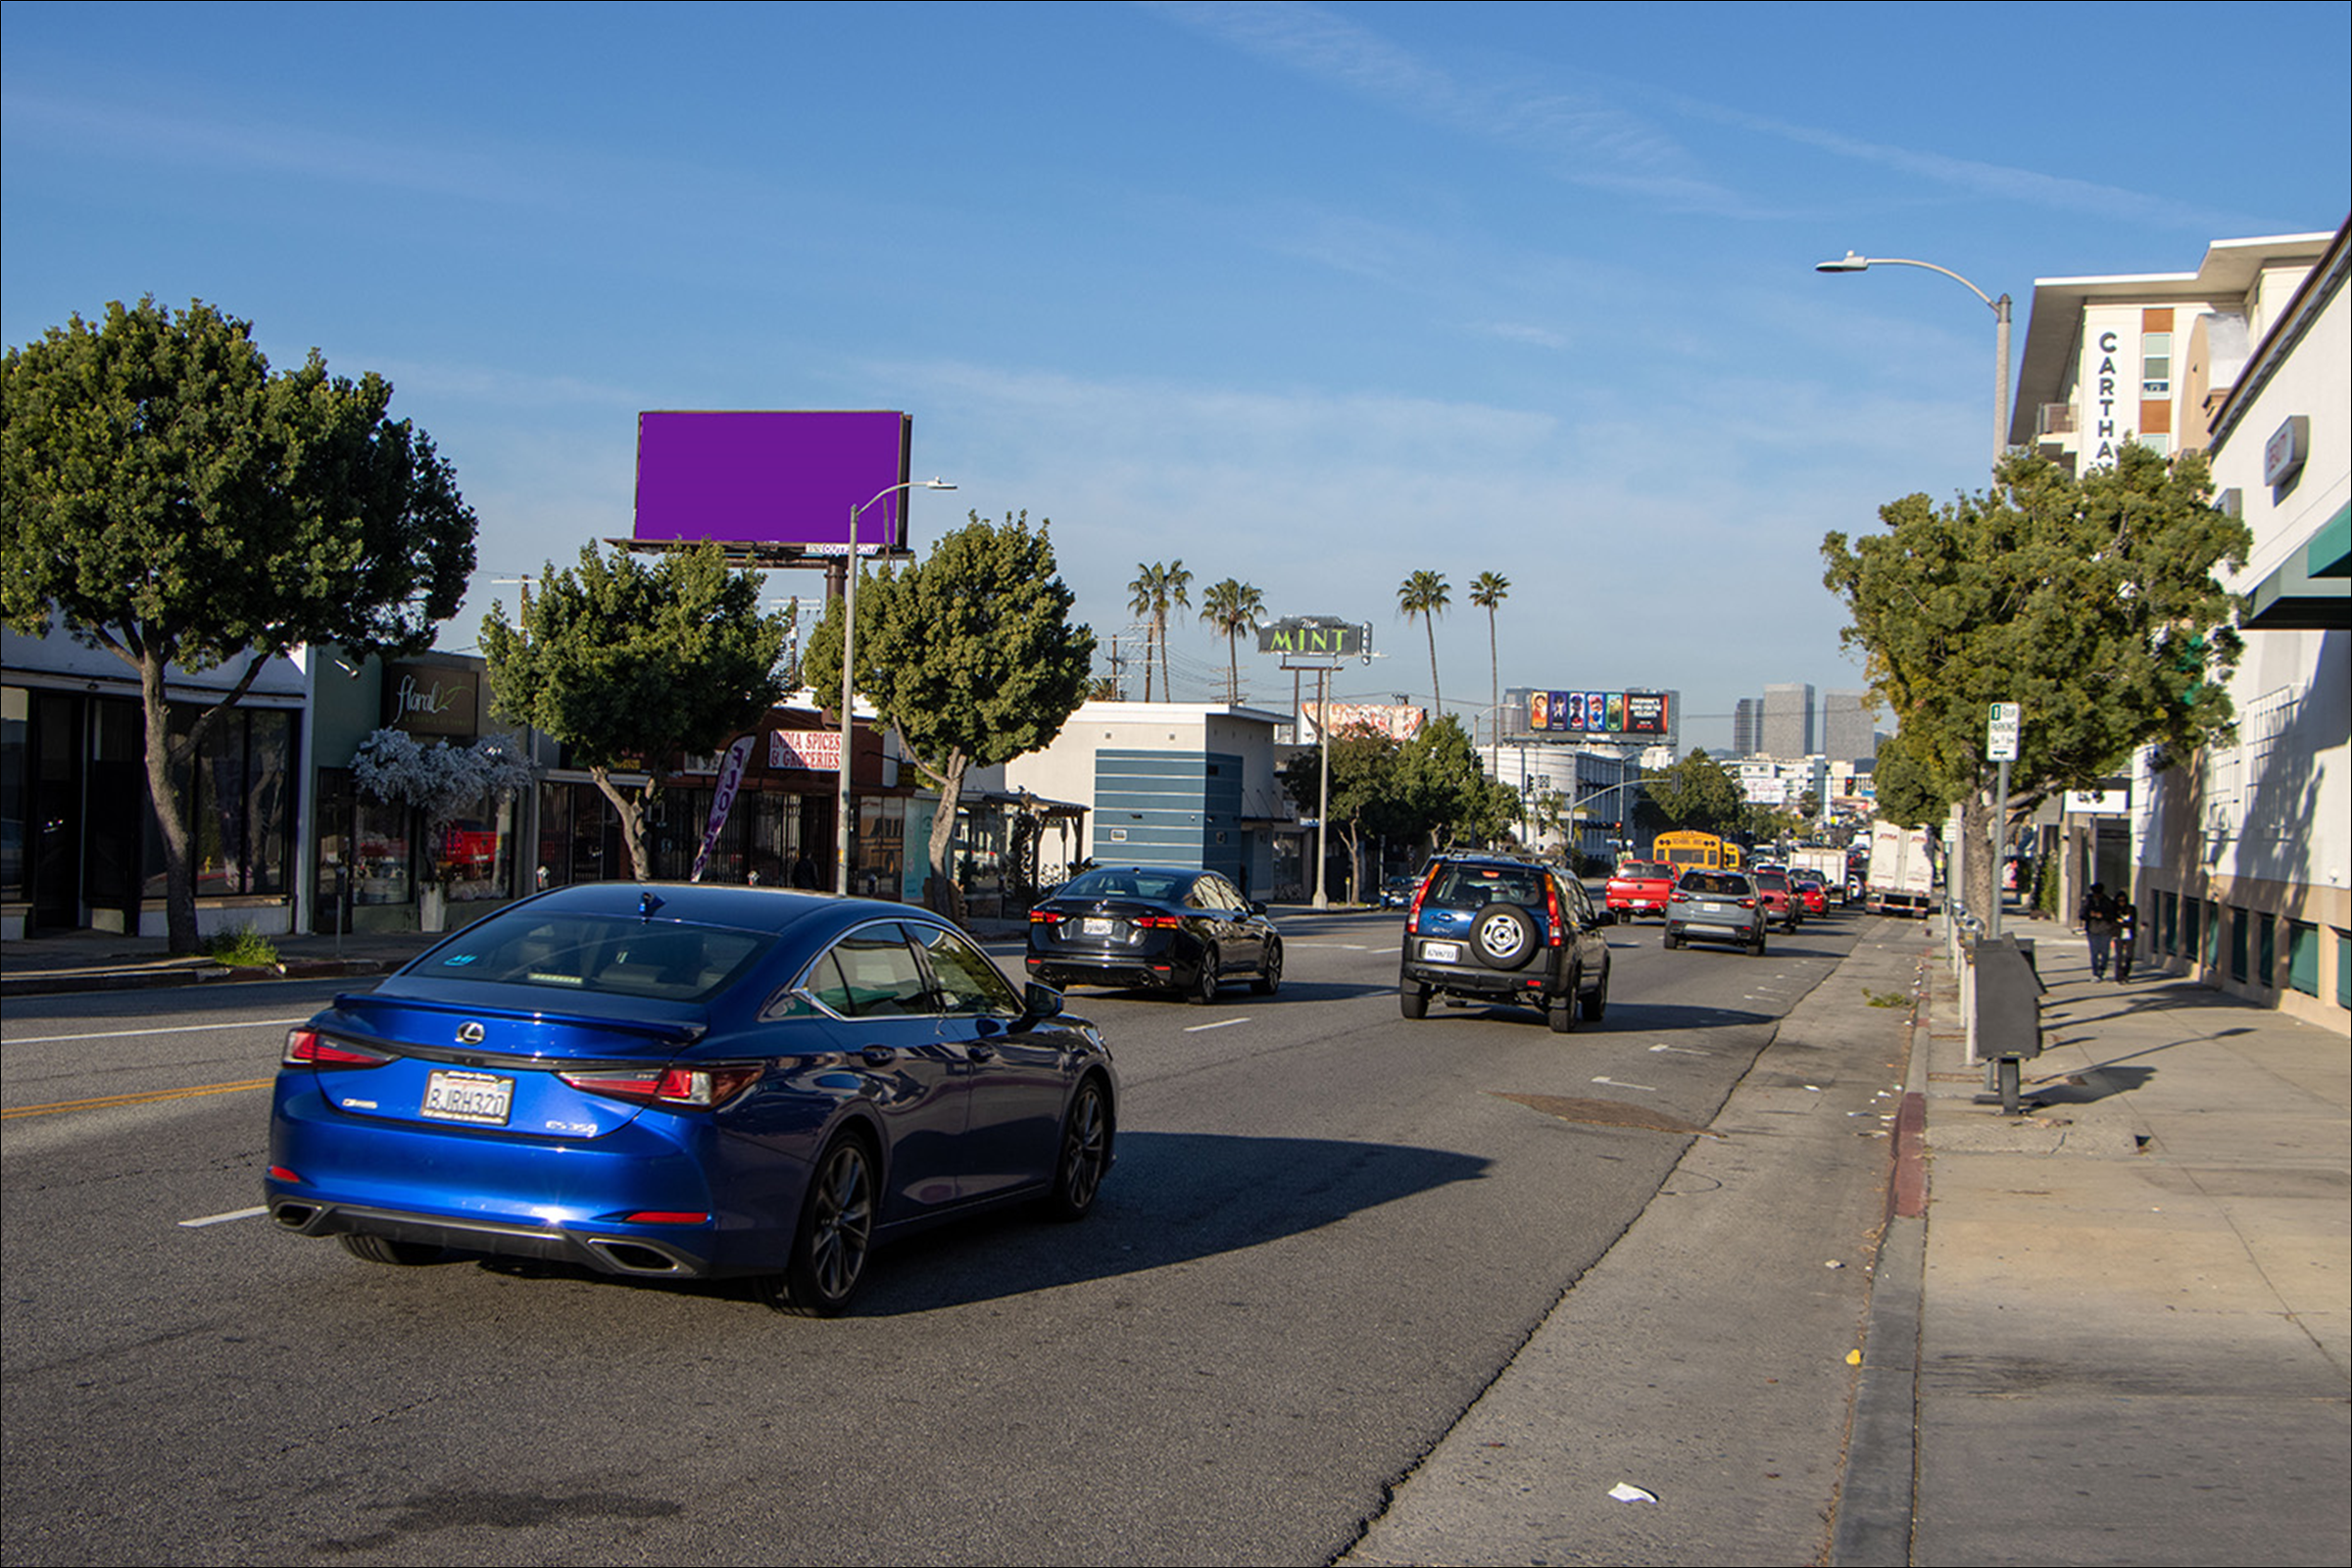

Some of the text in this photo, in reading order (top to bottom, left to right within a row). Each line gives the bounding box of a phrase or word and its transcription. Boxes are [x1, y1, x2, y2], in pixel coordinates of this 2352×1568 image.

[1270, 629, 1348, 651] MINT
[771, 732, 841, 751] INDIA SPICES
[771, 750, 840, 769] & GROCERIES
